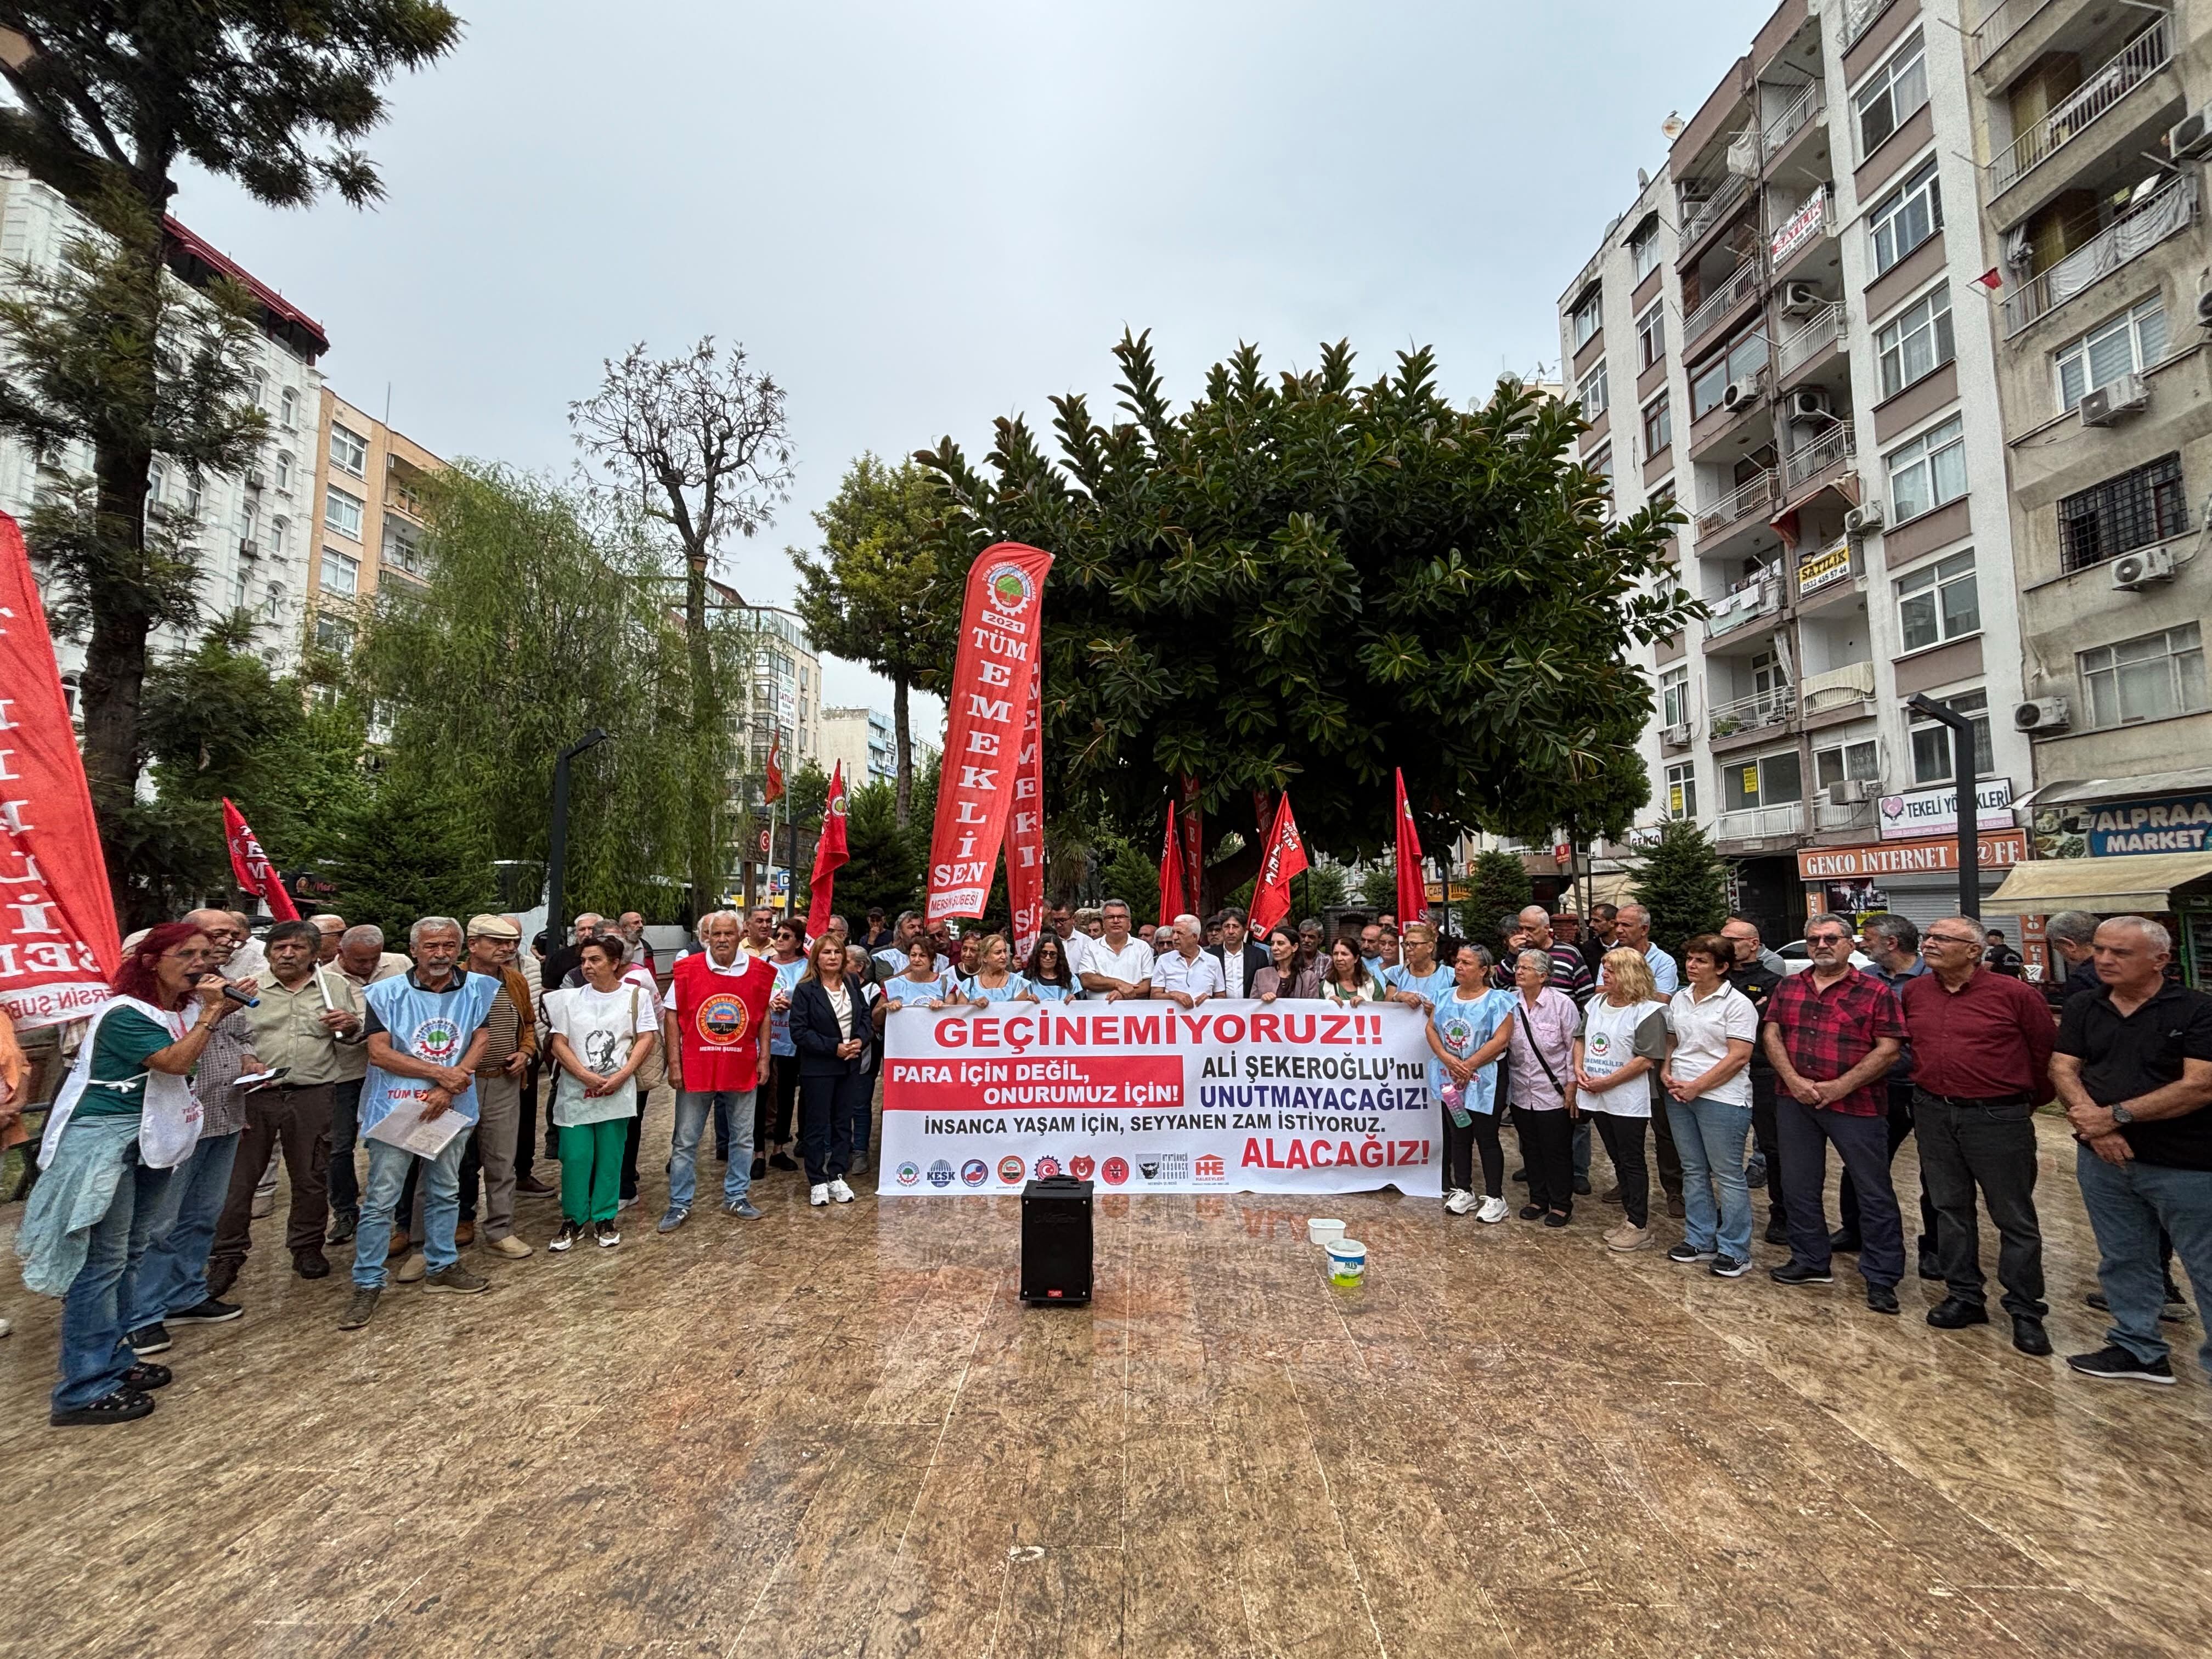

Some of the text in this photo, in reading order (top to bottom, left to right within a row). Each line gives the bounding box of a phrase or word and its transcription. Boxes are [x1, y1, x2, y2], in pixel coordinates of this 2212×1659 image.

[1775, 201, 1821, 251] SATILIK
[1802, 549, 1846, 580] SATILIK
[1803, 579, 1816, 590] 0533
[1830, 569, 1837, 578] 57
[1839, 565, 1847, 574] 44
[988, 614, 1022, 631] 2021
[972, 627, 1028, 662] TÜM
[779, 692, 794, 705] SATILIK
[956, 659, 1014, 859] EMEKLİ
[1906, 786, 2008, 818] TEKELİ YÖKLERİ
[2107, 829, 2204, 853] MARKET
[1807, 840, 2019, 874] GENCO İNTERNET @FE
[934, 861, 987, 887] SEN
[952, 894, 978, 909] ŞUBESİ
[934, 1008, 1382, 1054] GEÇİNEMİYORUZ!!
[893, 1060, 1089, 1086] PARA İÇİN DEĞİL,
[1201, 1051, 1424, 1083] ALİ ŞEKEROĞLU’nu
[1590, 1058, 1624, 1067] EMEKLİLER
[387, 1088, 411, 1099] TÜM
[984, 1081, 1178, 1107] ONURUMUZ İÇİN!
[1200, 1082, 1427, 1110] UNUTMAYACAĞIZ!
[924, 1110, 1385, 1136] İNSANCA YAŞAM İÇİN, SEYYANEN ZAM İSTİYORUZ.
[1242, 1134, 1430, 1170] ALACAĞIZ!
[927, 1172, 955, 1180] KESK
